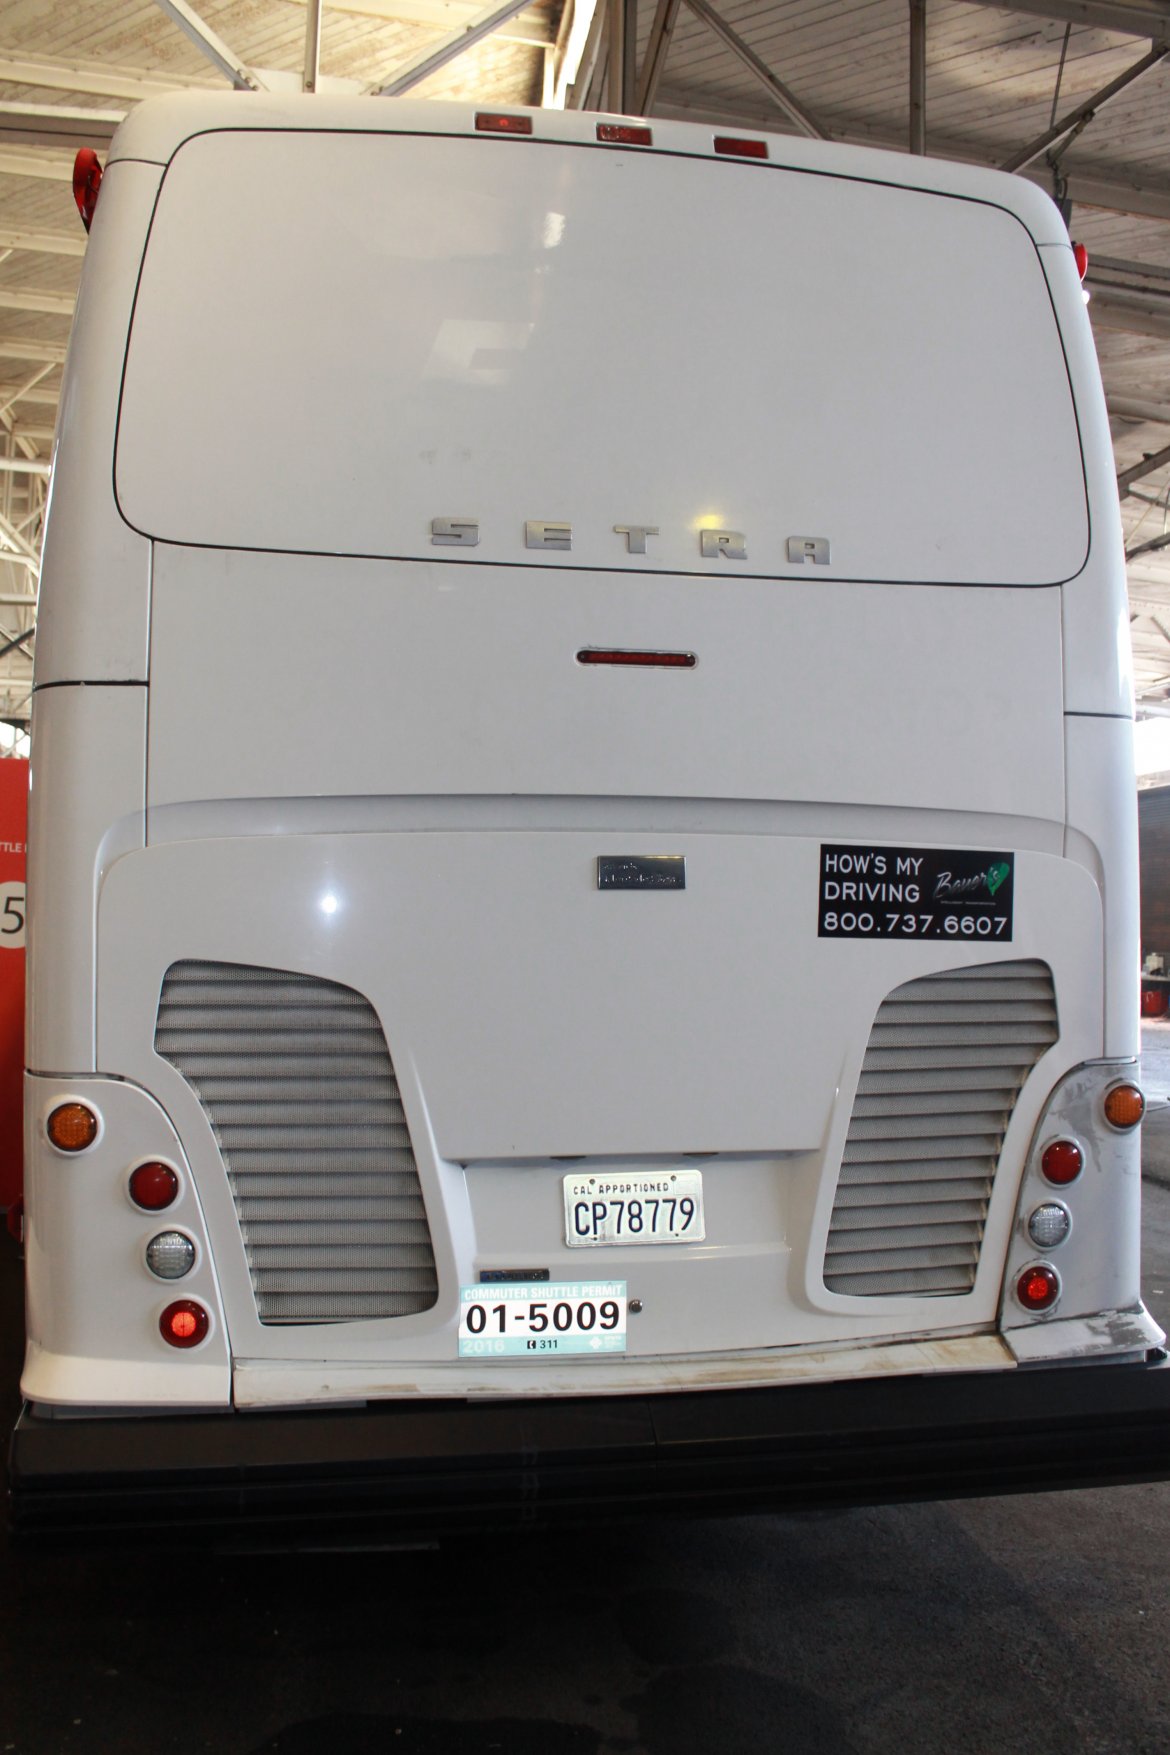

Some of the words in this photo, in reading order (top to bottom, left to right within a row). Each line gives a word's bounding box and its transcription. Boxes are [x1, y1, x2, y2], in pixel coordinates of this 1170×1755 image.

[431, 517, 831, 565] SETRA
[825, 853, 887, 875] HOW'S
[896, 857, 924, 875] MY
[824, 881, 920, 903] DRIVING
[932, 867, 1002, 898] Bauer's
[1, 897, 24, 934] 5
[824, 912, 1008, 935] 800.737.6607
[573, 1186, 592, 1195] CAL
[599, 1182, 669, 1194] APPORTIONED
[574, 1197, 695, 1236] CP78779
[464, 1287, 528, 1300] COMMUTER
[531, 1285, 579, 1298] SHUTTLE
[581, 1284, 623, 1297] PERMIT
[466, 1301, 619, 1334] 01-5009
[539, 1340, 558, 1349] 311
